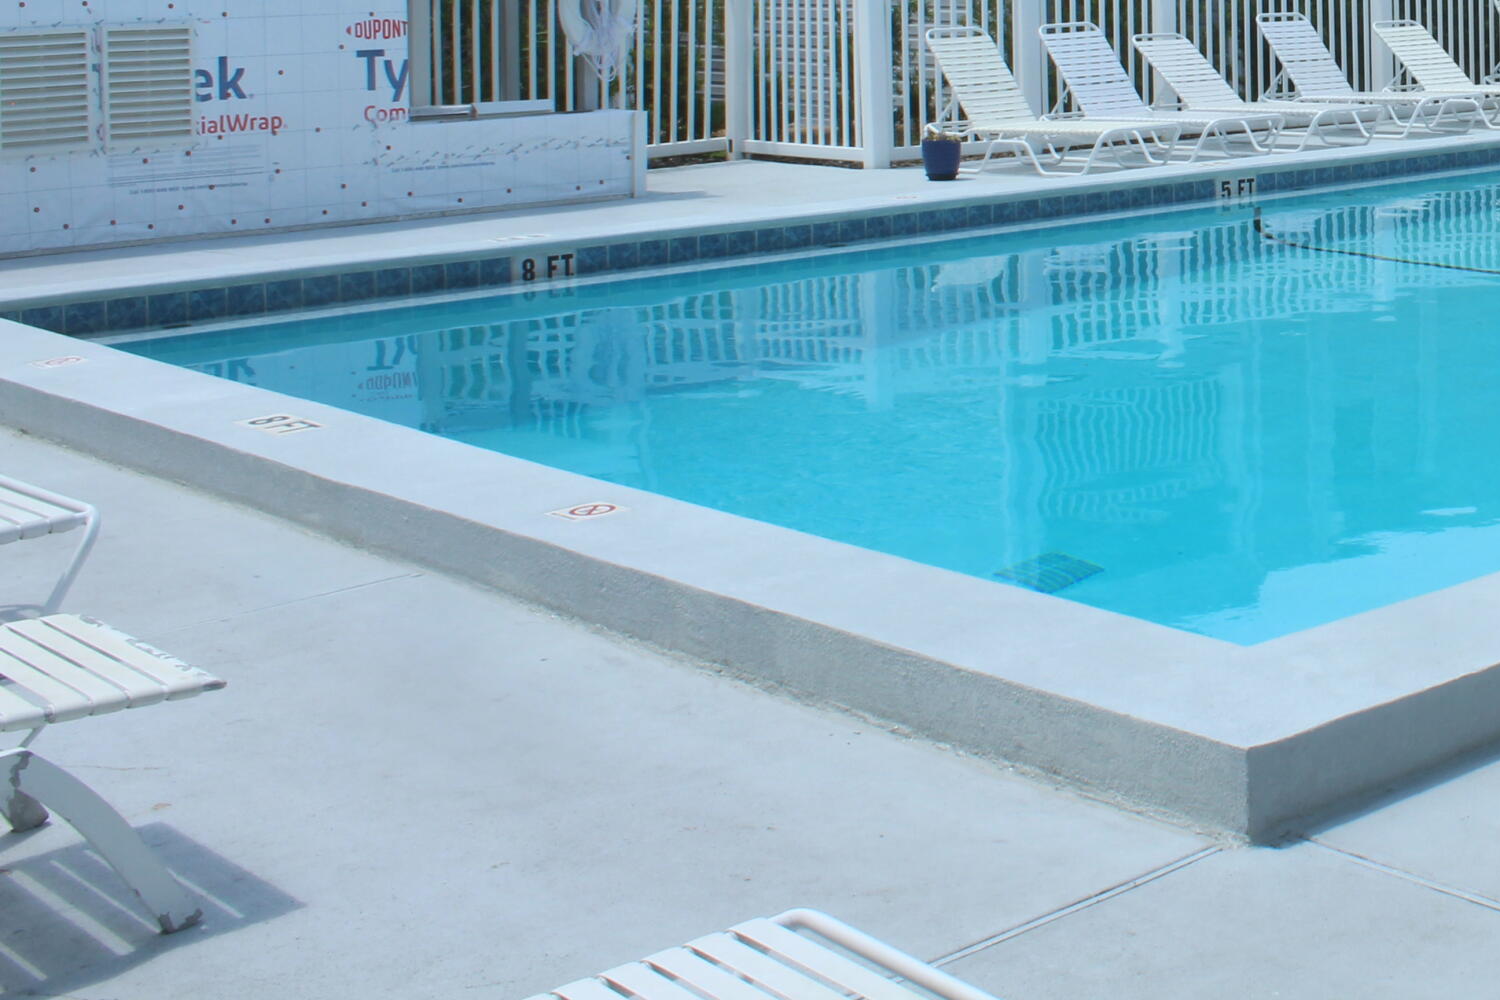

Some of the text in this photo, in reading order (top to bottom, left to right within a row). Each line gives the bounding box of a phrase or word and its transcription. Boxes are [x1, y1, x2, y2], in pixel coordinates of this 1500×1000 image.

[354, 18, 409, 40] DUPONT
[196, 112, 284, 137] ialWrap
[363, 104, 410, 124] Com
[1221, 177, 1255, 198] 5 FT
[521, 257, 537, 282] 8
[247, 415, 322, 434] 8 FT
